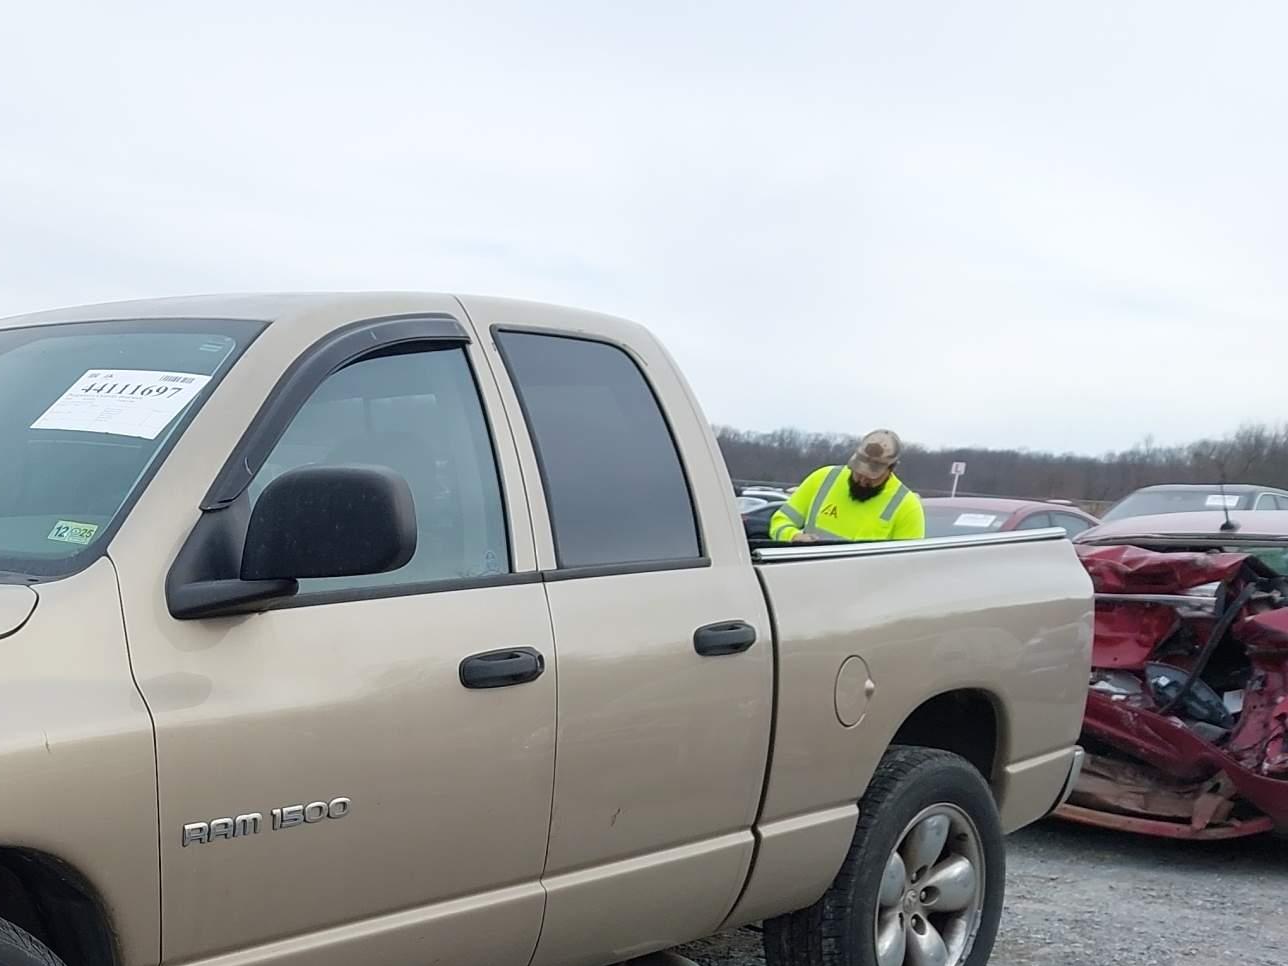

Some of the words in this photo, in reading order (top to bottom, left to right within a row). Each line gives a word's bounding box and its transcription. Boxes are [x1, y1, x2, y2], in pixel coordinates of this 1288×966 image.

[81, 382, 183, 399] 44111697
[54, 526, 69, 538] 12
[79, 528, 94, 538] 25
[182, 812, 262, 848] RAM
[271, 797, 352, 831] 1500
